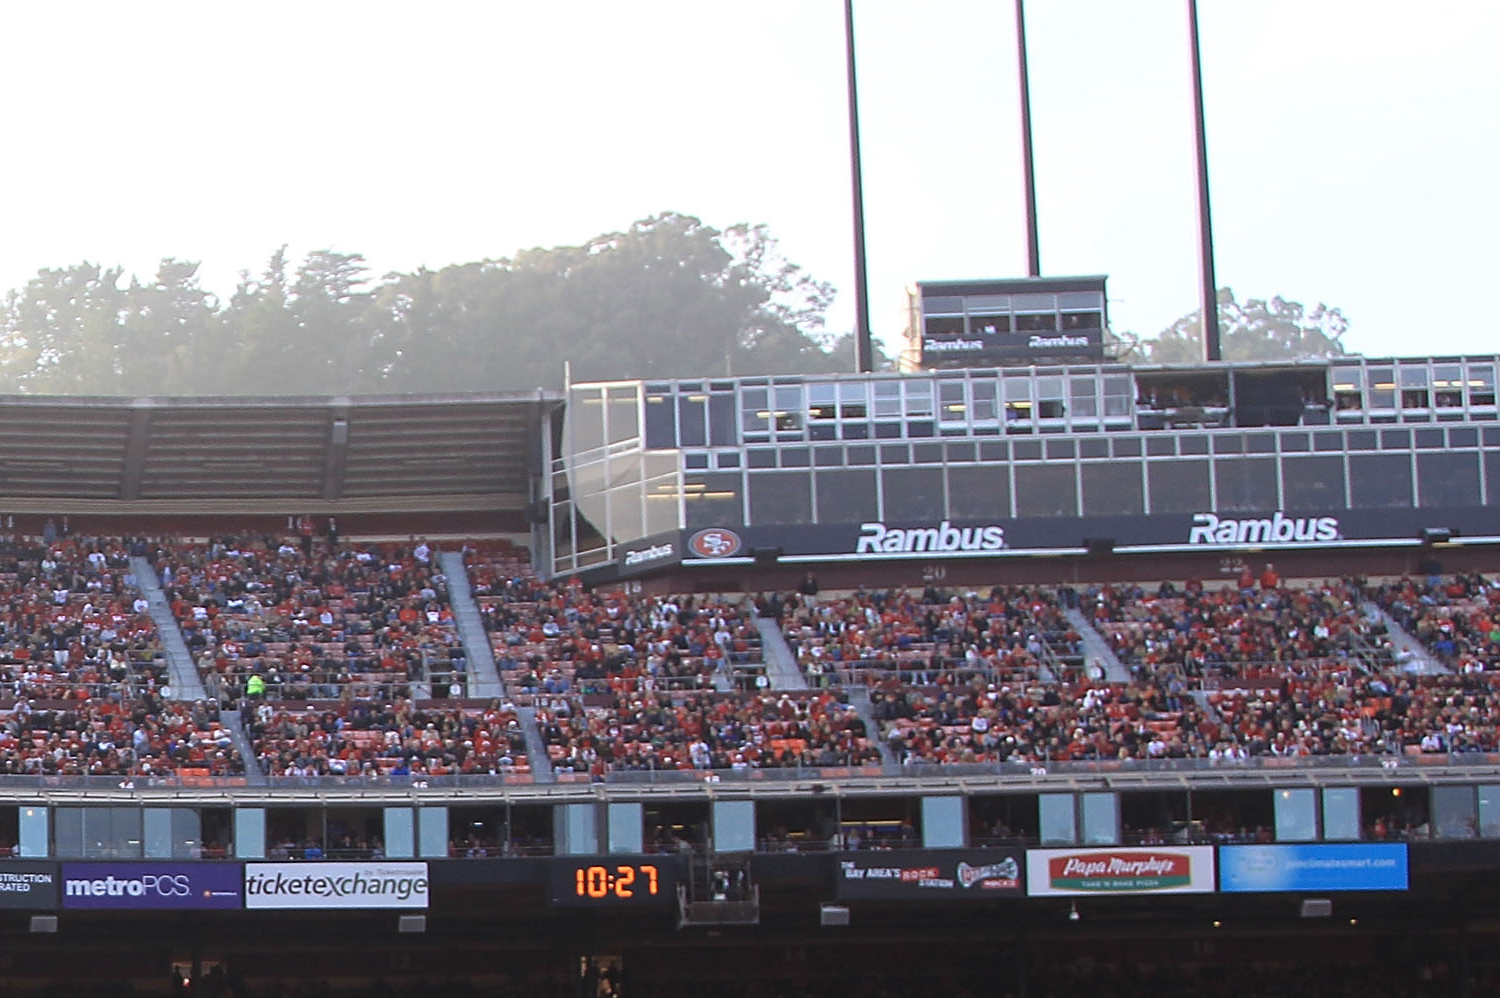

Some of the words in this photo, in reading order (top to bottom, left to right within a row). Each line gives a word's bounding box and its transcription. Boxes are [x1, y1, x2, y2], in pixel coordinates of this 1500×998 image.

[925, 339, 984, 350] Rambus
[1029, 335, 1089, 348] Rambus
[856, 521, 1004, 553] Rambus
[1189, 513, 1338, 544] Rambus
[625, 543, 673, 565] Rambus
[922, 566, 946, 580] 20
[845, 869, 865, 879] BAY
[866, 868, 900, 878] AREA'S
[902, 869, 935, 880] ROCK
[1063, 857, 1107, 876] Papa
[66, 874, 190, 896] metroPCS
[576, 865, 658, 898] 10:27
